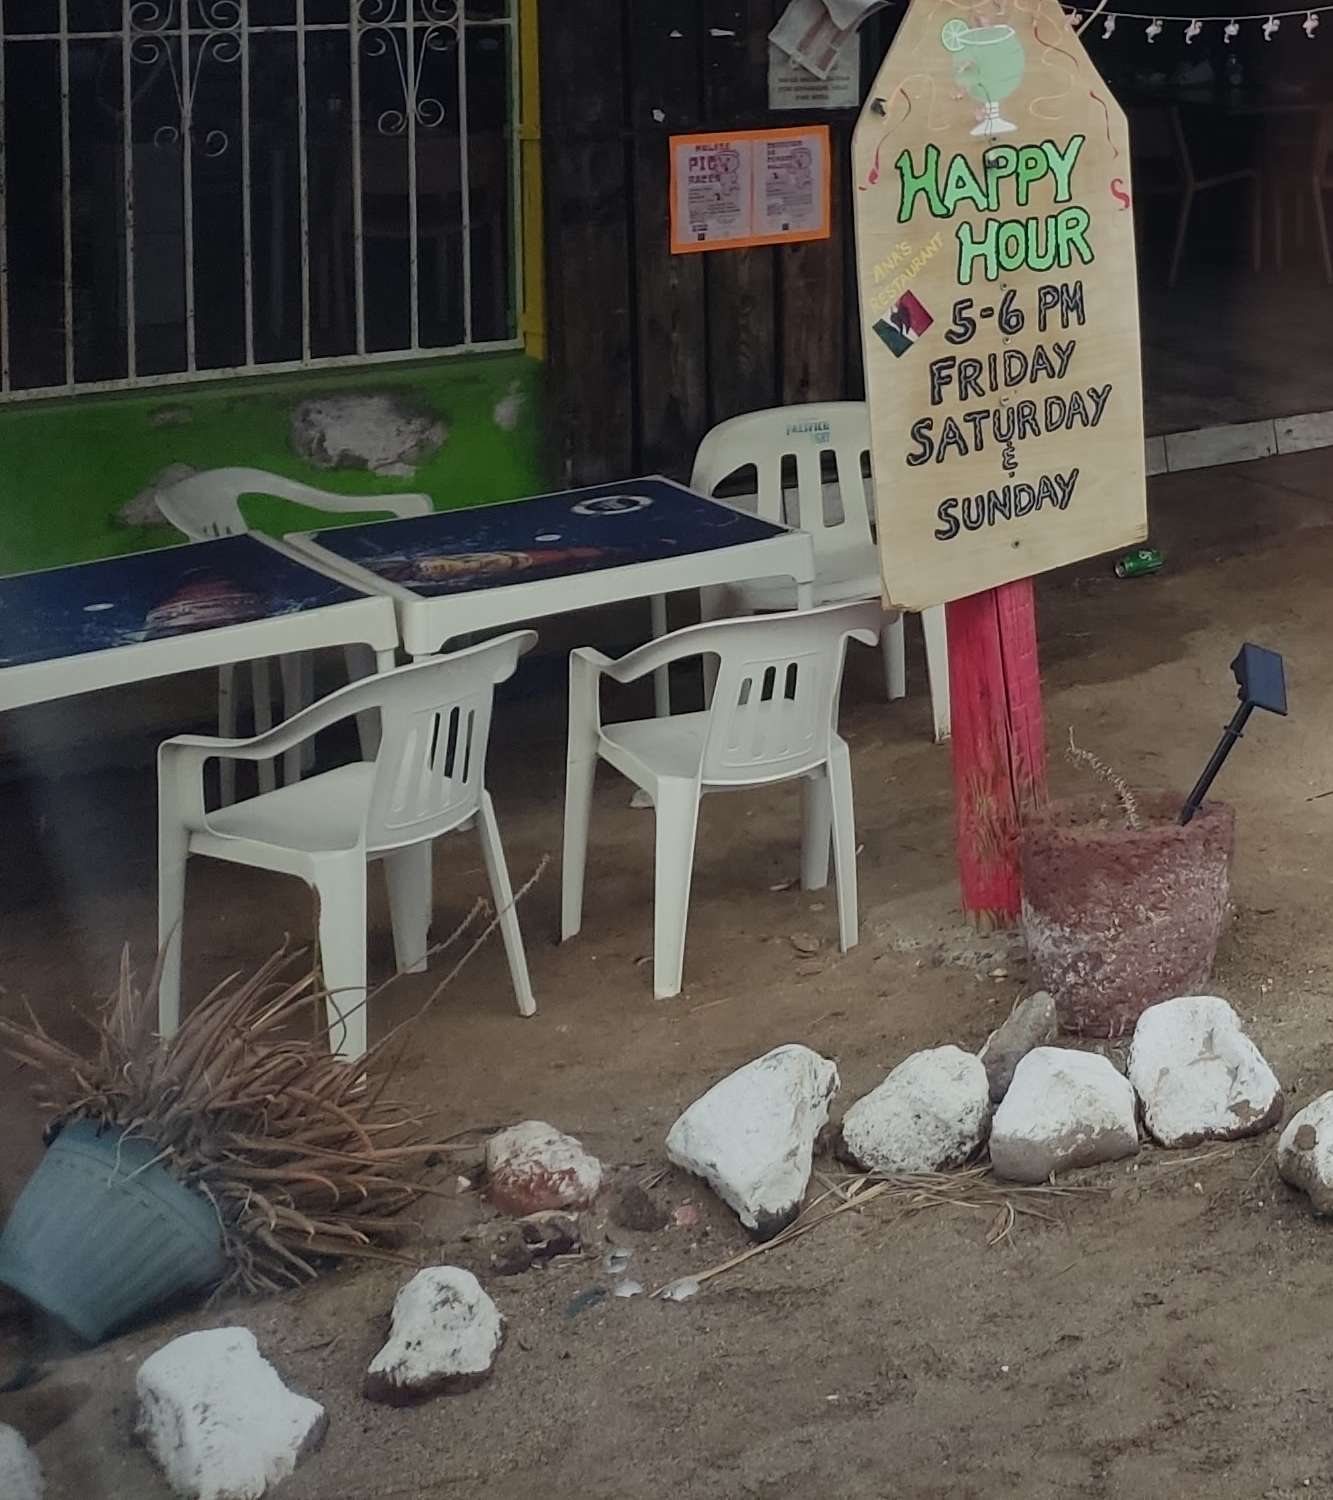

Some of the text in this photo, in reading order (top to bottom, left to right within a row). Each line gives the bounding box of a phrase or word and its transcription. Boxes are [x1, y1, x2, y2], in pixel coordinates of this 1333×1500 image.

[894, 133, 1086, 224] HAPPY
[869, 231, 944, 315] RESTAURANT
[873, 241, 913, 284] ANA'S
[954, 205, 1095, 286] HOUR
[944, 280, 1087, 346] 5-6 PM
[929, 339, 1077, 407] FRIDAY
[905, 383, 1113, 468] SATURDAY
[934, 467, 1080, 542] SUNDAY
